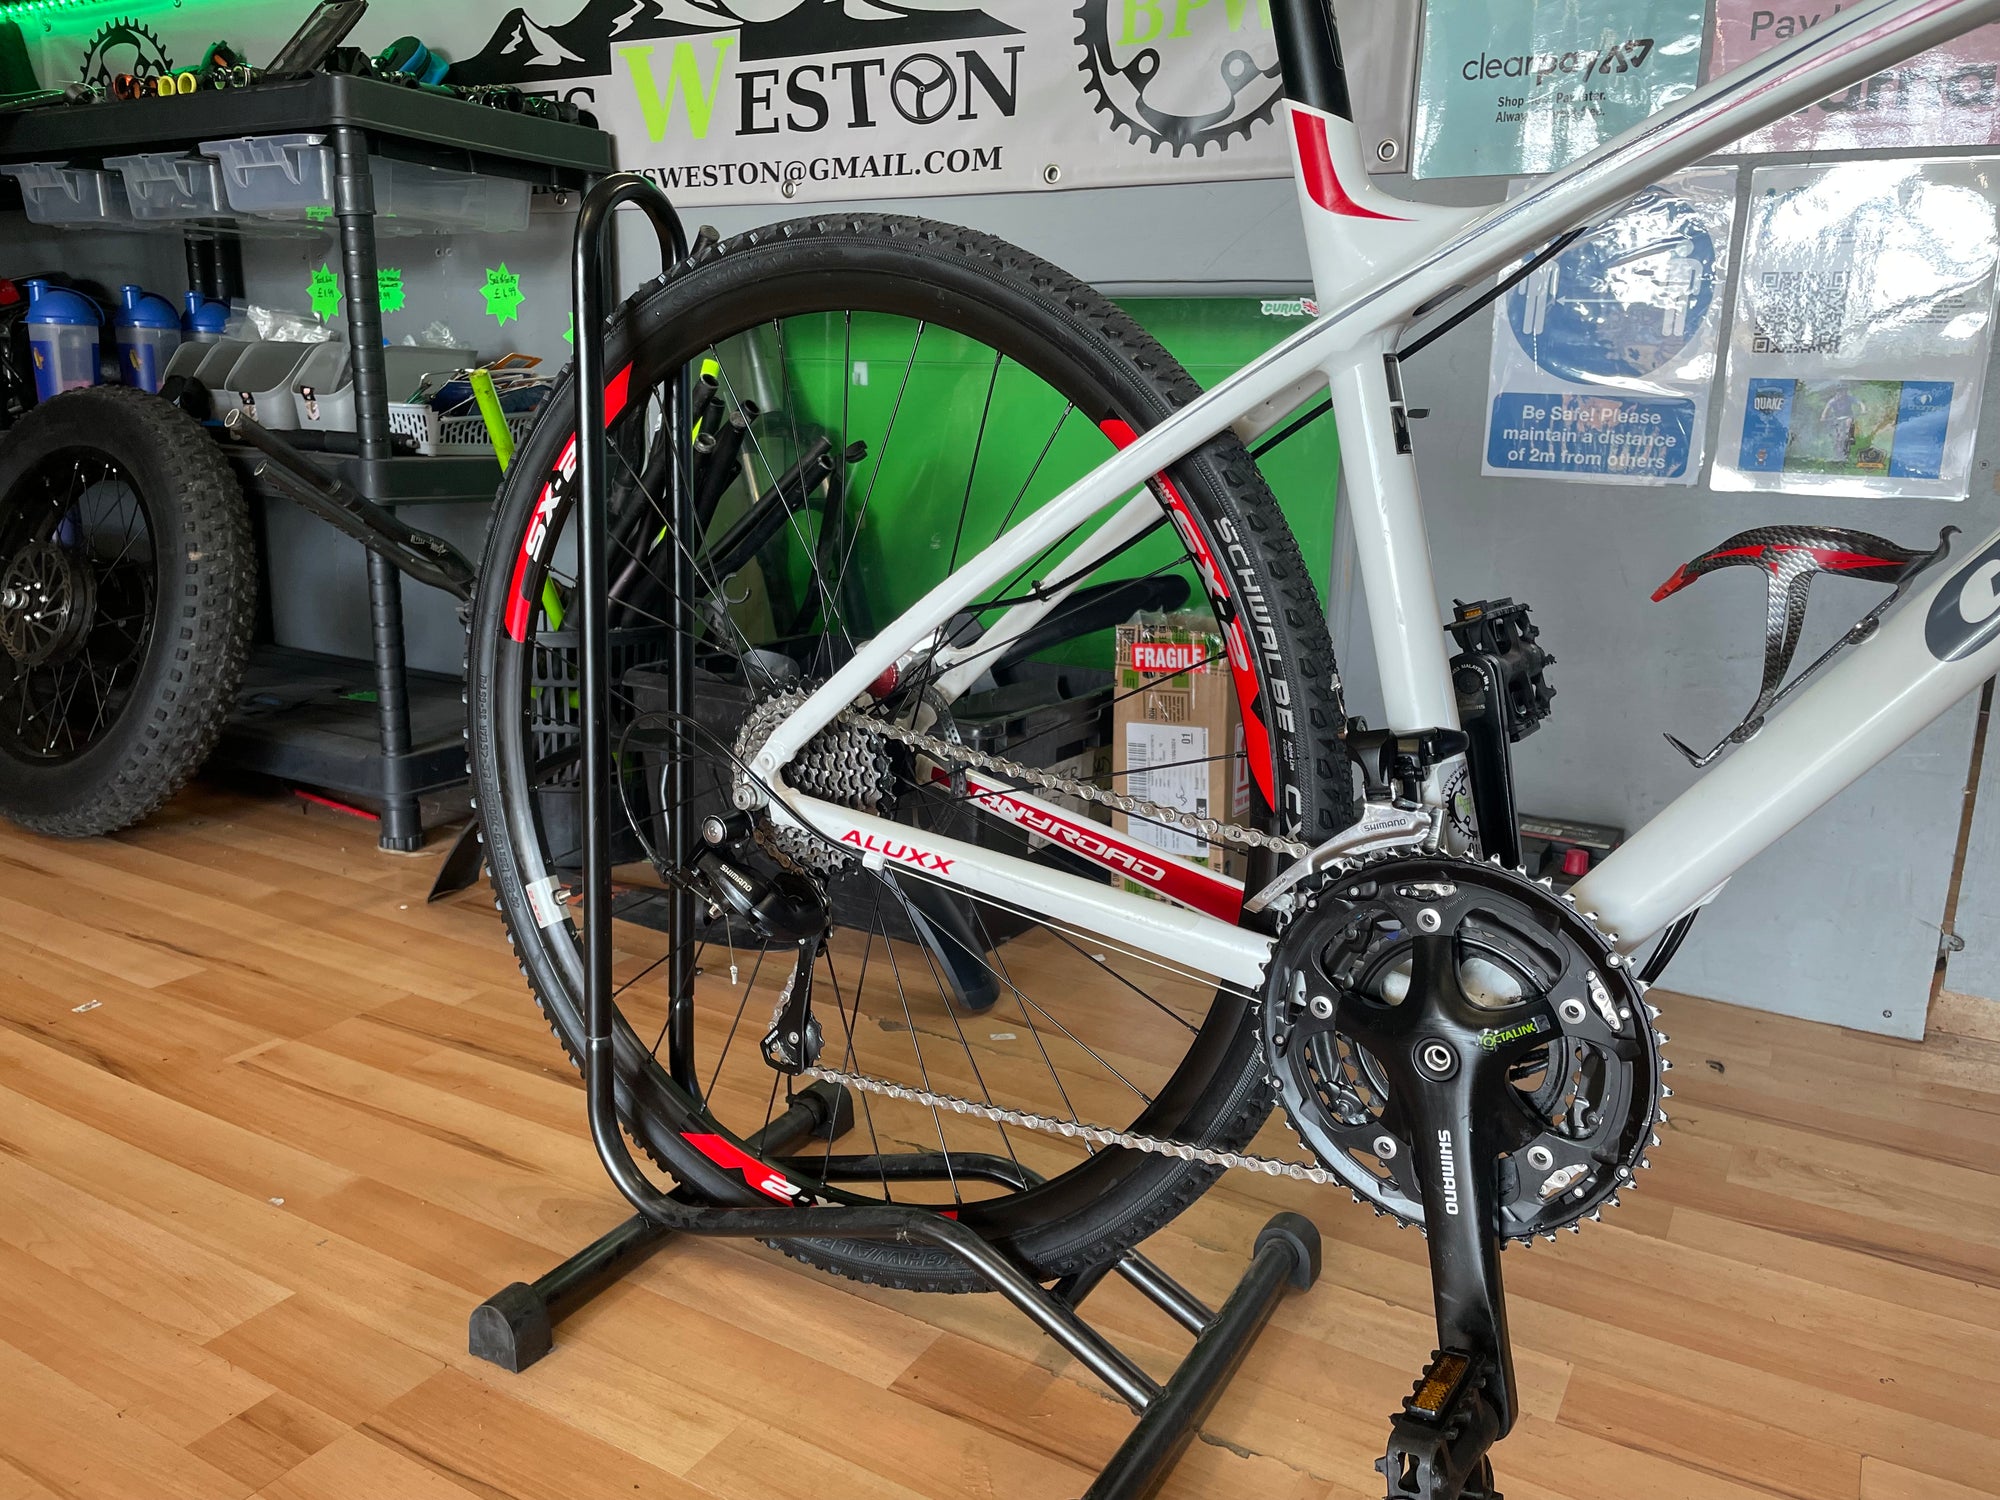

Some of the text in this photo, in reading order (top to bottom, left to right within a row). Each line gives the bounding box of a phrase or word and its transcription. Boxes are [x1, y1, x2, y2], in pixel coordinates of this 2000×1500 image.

[1462, 49, 1600, 86] clearpay
[619, 36, 1025, 144] WESTON
[1498, 96, 1524, 108] Shop
[1522, 405, 1662, 426] Be Safe! Please
[1754, 396, 1785, 411] QUAKE
[1503, 427, 1677, 448] maintain a distance
[1507, 448, 1666, 470] of 2m from others
[1167, 509, 1249, 672] SX-2
[1213, 516, 1296, 733] SCHWALBE
[1134, 647, 1202, 669] FRAGILE
[1181, 733, 1191, 745] 01
[1285, 783, 1302, 843] CX
[1364, 818, 1407, 832] SHIMANO
[972, 787, 1167, 882] ANYROAD
[840, 829, 956, 875] ALUXX
[720, 863, 753, 892] SHIMANO
[1482, 1022, 1537, 1048] OCTALINK
[1438, 1129, 1459, 1215] SHIMANO
